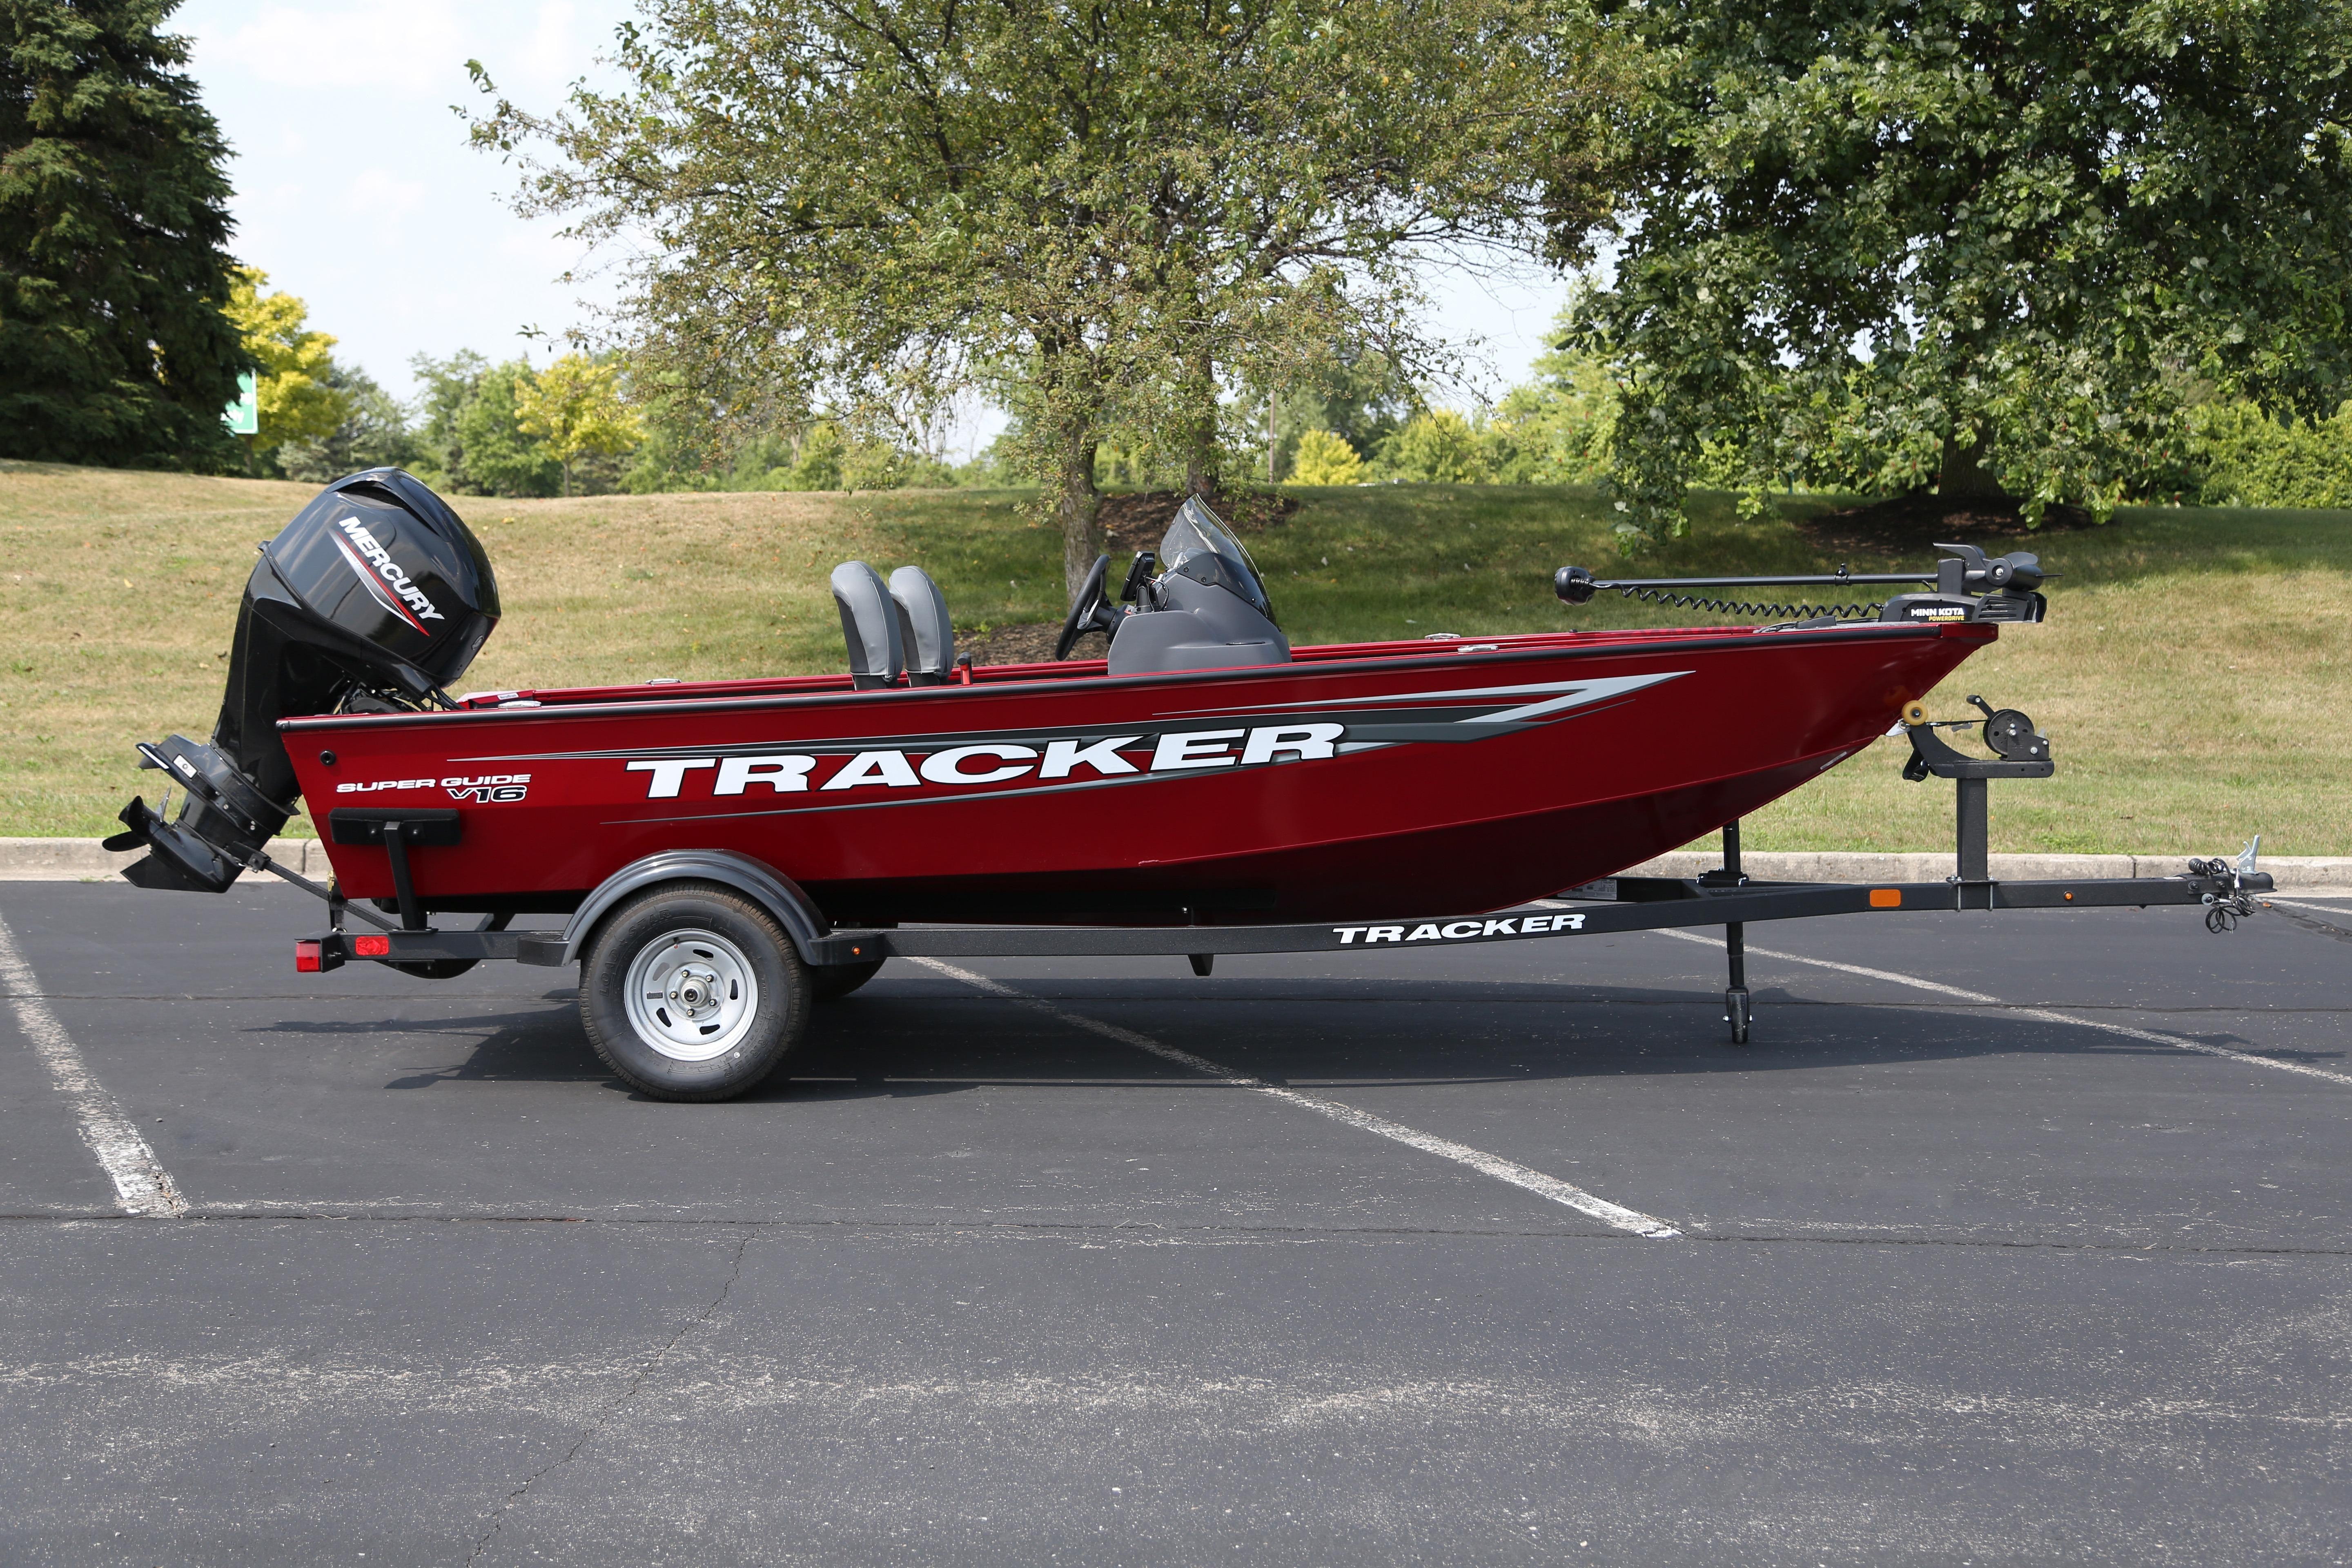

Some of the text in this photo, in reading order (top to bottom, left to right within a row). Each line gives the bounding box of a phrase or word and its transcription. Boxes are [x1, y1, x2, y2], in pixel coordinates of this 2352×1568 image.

[338, 516, 445, 620] MERCURY
[1911, 607, 1964, 617] MINN KOTA
[626, 722, 1345, 798] TRACKER
[336, 774, 531, 793] SUPER GUIDE
[447, 785, 528, 803] V16
[628, 908, 672, 938] STAR
[1332, 913, 1586, 944] TRACKER
